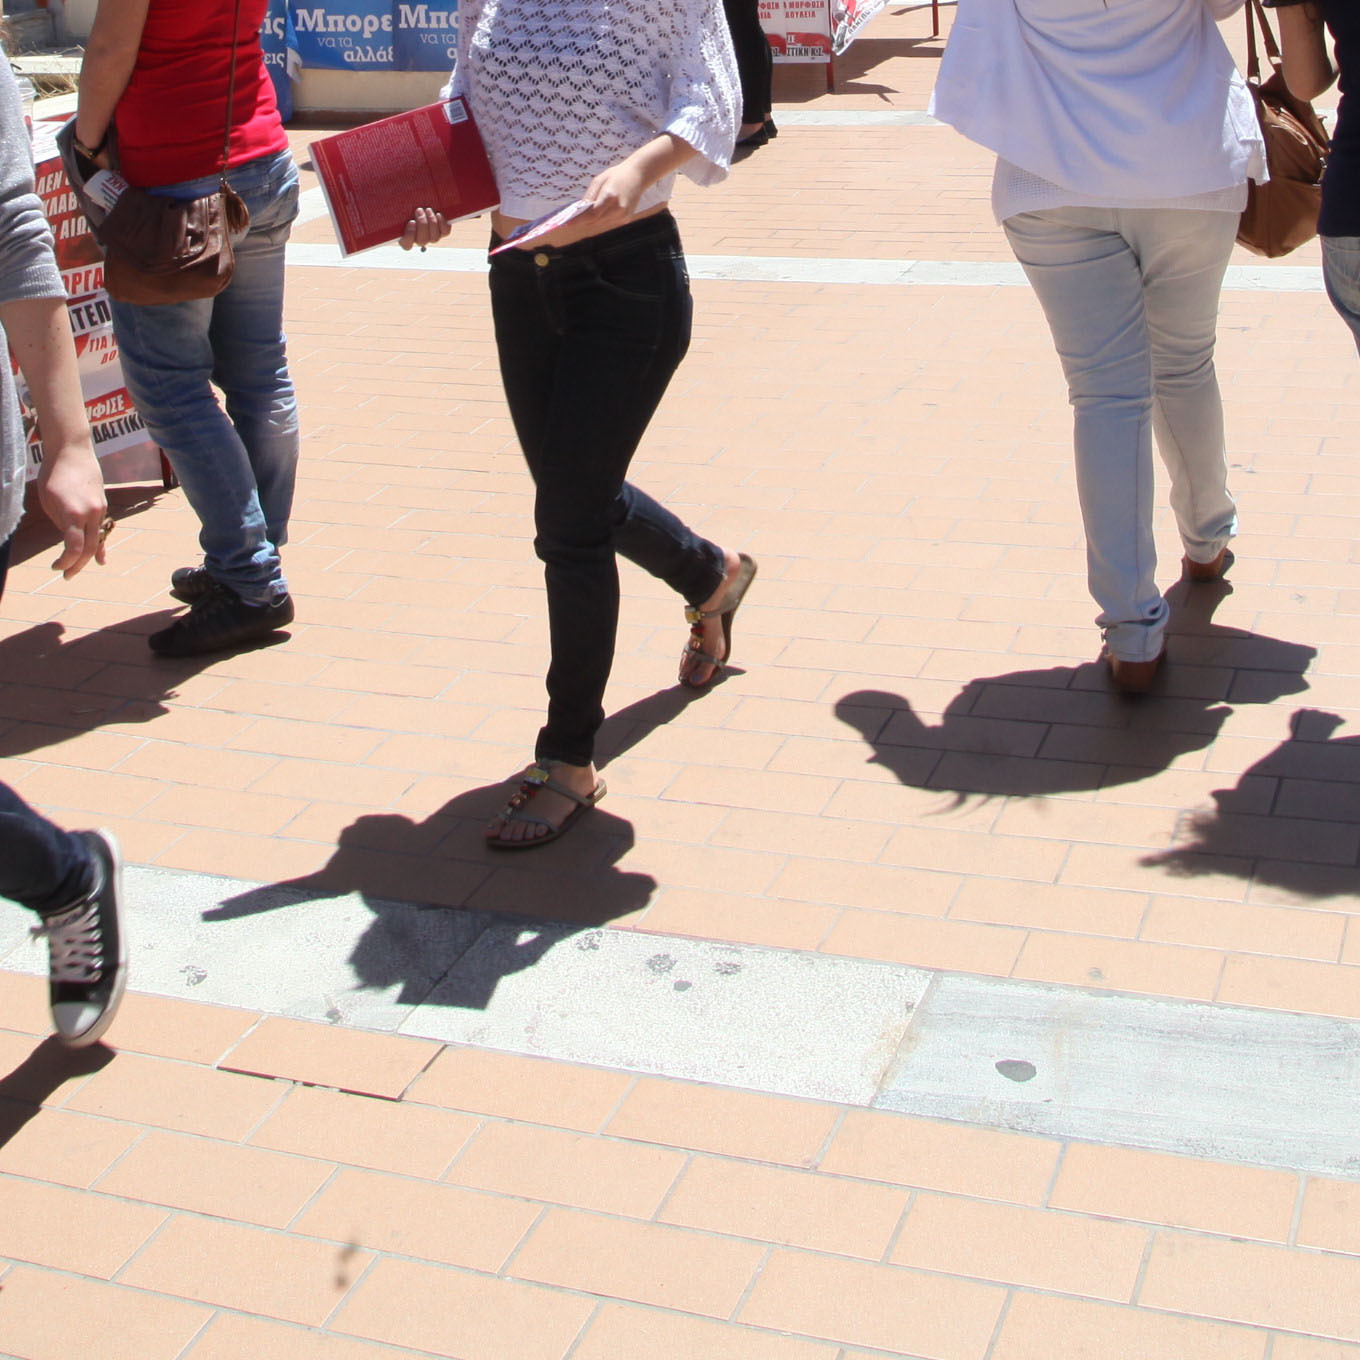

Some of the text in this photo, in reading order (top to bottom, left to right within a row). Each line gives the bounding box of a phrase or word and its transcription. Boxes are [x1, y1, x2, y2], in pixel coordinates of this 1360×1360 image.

[295, 8, 392, 39] Μπορε
[317, 37, 353, 49] να τα
[420, 33, 438, 45] να
